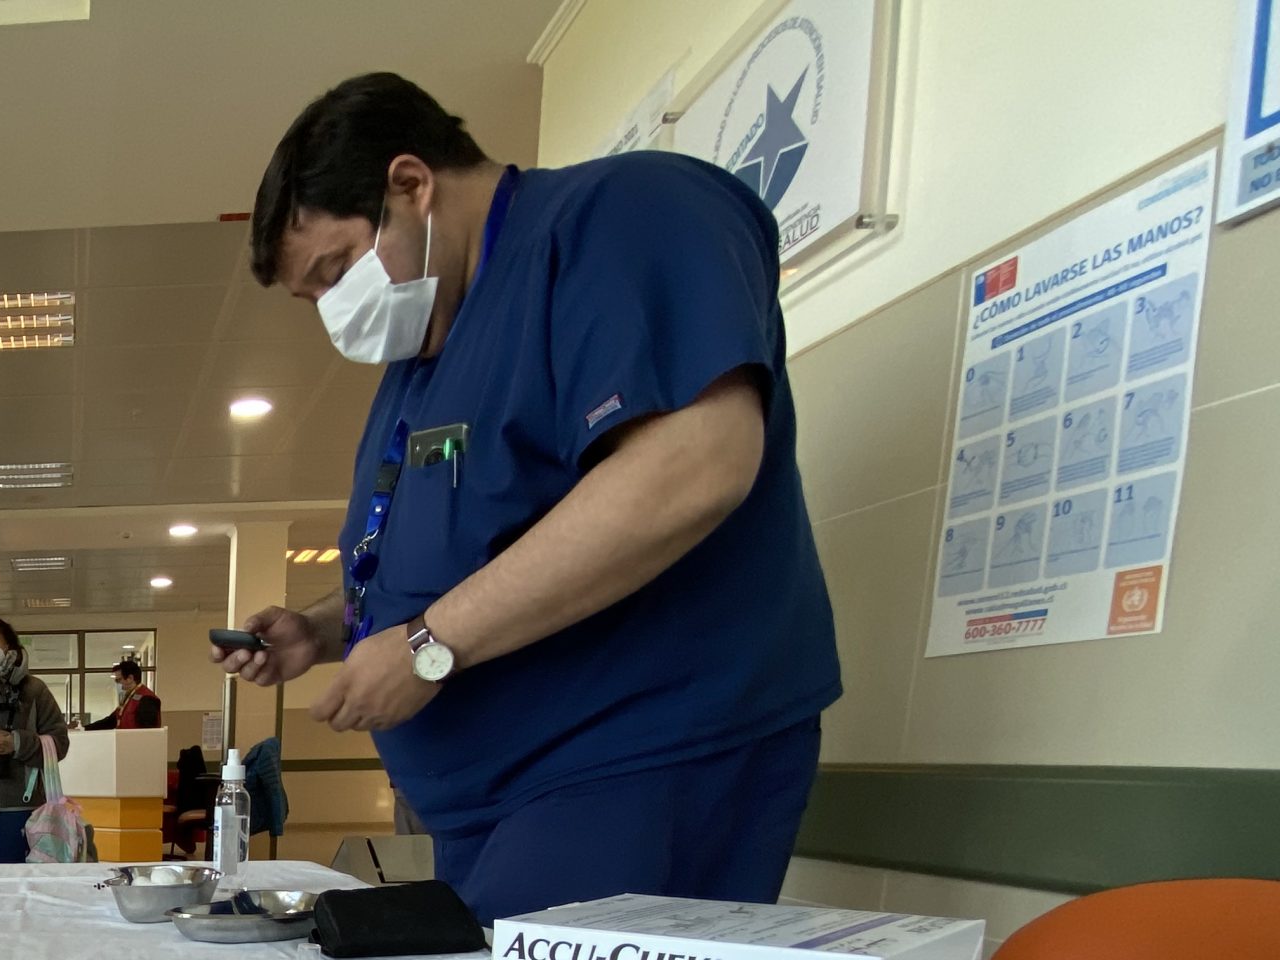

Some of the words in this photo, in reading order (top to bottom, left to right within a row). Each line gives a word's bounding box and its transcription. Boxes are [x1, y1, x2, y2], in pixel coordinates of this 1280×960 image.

[974, 292, 1020, 329] ¿CÓMO
[1025, 259, 1087, 300] LAVARSE
[1092, 244, 1121, 270] LAS
[1127, 207, 1203, 254] MANOS?
[1136, 297, 1145, 313] 3
[1072, 323, 1082, 338] 2
[1017, 346, 1024, 362] 1
[966, 368, 974, 382] 0
[1124, 392, 1135, 410] 7
[1063, 413, 1072, 428] 6
[1007, 433, 1015, 447] 5
[957, 450, 964, 462] 4
[1114, 485, 1134, 502] 11
[1053, 500, 1072, 517] 10
[996, 516, 1005, 530] 9
[945, 529, 954, 542] 8
[964, 617, 1046, 640] 600-360-7777
